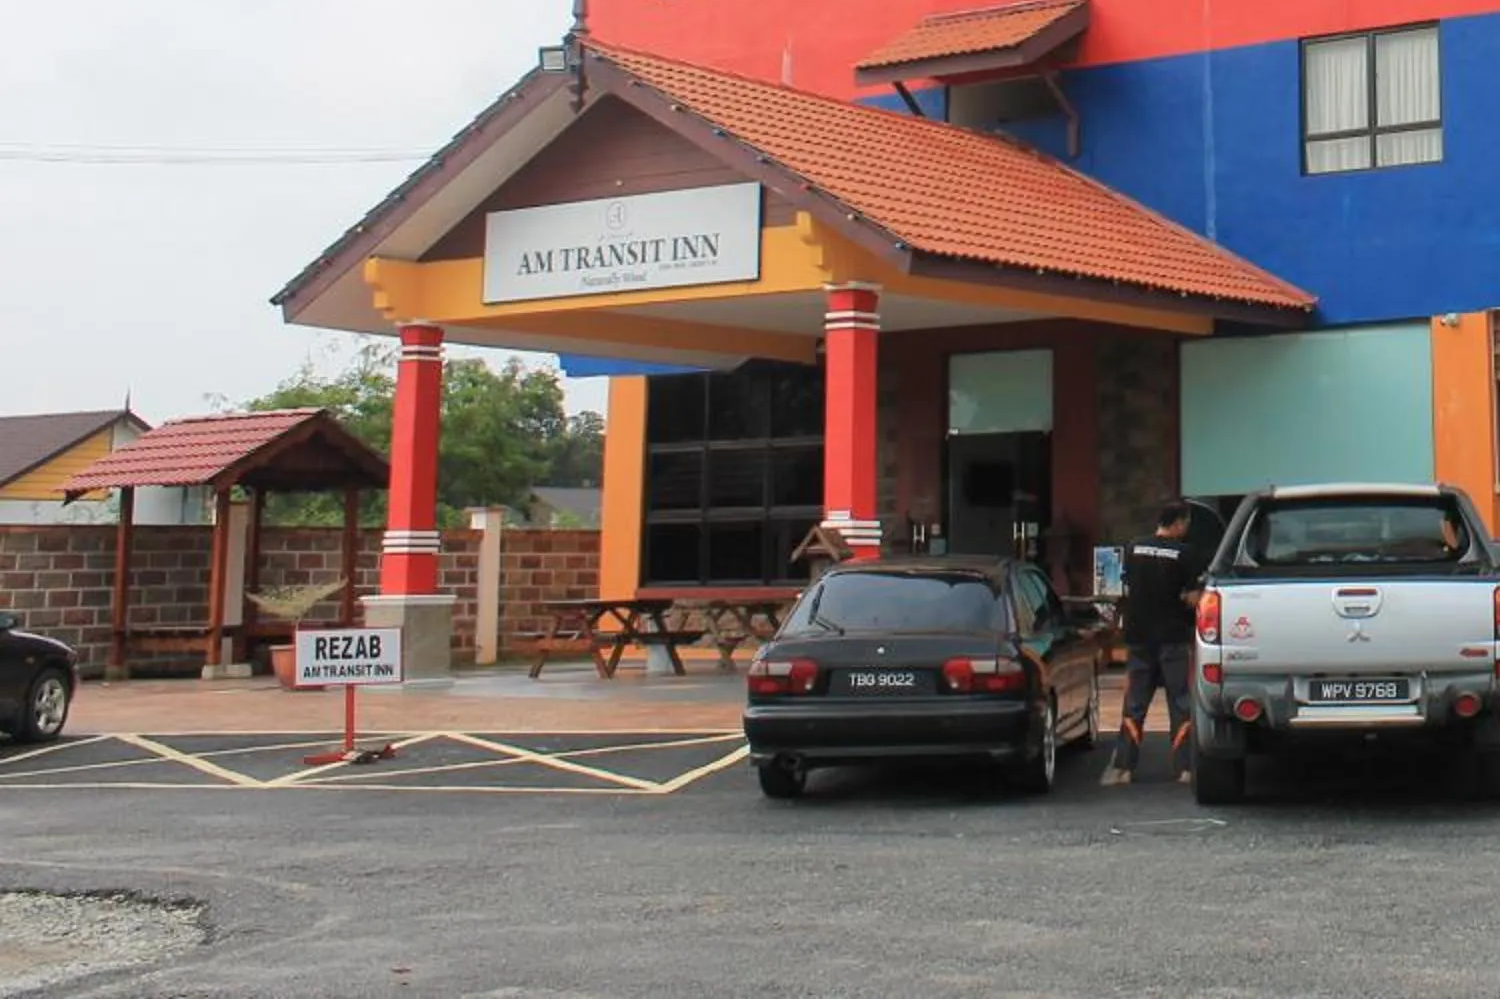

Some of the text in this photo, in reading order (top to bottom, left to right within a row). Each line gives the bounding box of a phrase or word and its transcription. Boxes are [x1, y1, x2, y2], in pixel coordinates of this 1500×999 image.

[517, 233, 720, 275] AM TRANSIT INN
[315, 635, 382, 660] REZAB
[303, 664, 394, 678] AM TRANSIT INN
[877, 672, 916, 687] 9022
[1321, 683, 1397, 698] WPV 9768
